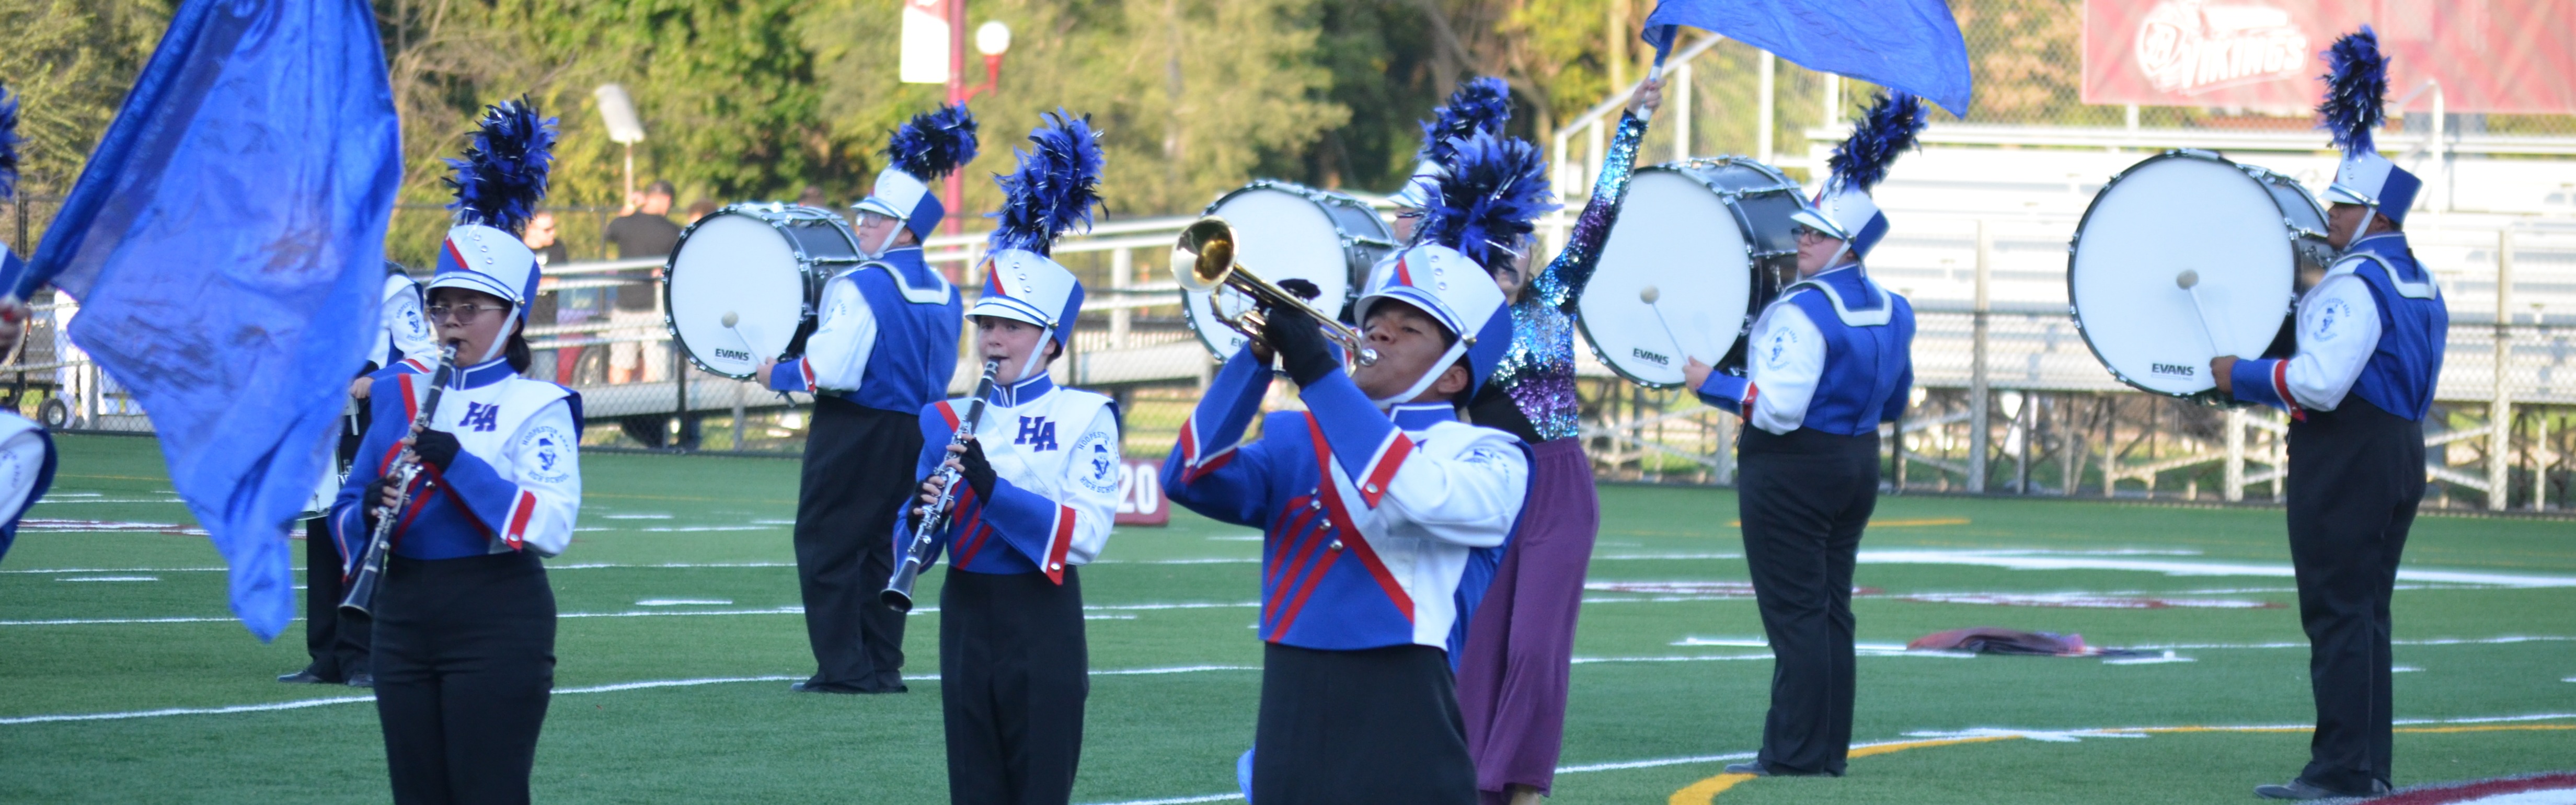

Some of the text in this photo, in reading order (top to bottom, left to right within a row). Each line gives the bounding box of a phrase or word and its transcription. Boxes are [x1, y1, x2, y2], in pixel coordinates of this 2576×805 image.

[2181, 36, 2307, 89] VIKINGS
[715, 348, 750, 361] EVANS
[1632, 348, 1670, 365] EVANS
[2152, 363, 2194, 376] EVANS
[458, 401, 500, 432] HA
[1014, 415, 1059, 453] HA
[1079, 476, 1097, 491] HIGH
[1116, 464, 1158, 514] 20
